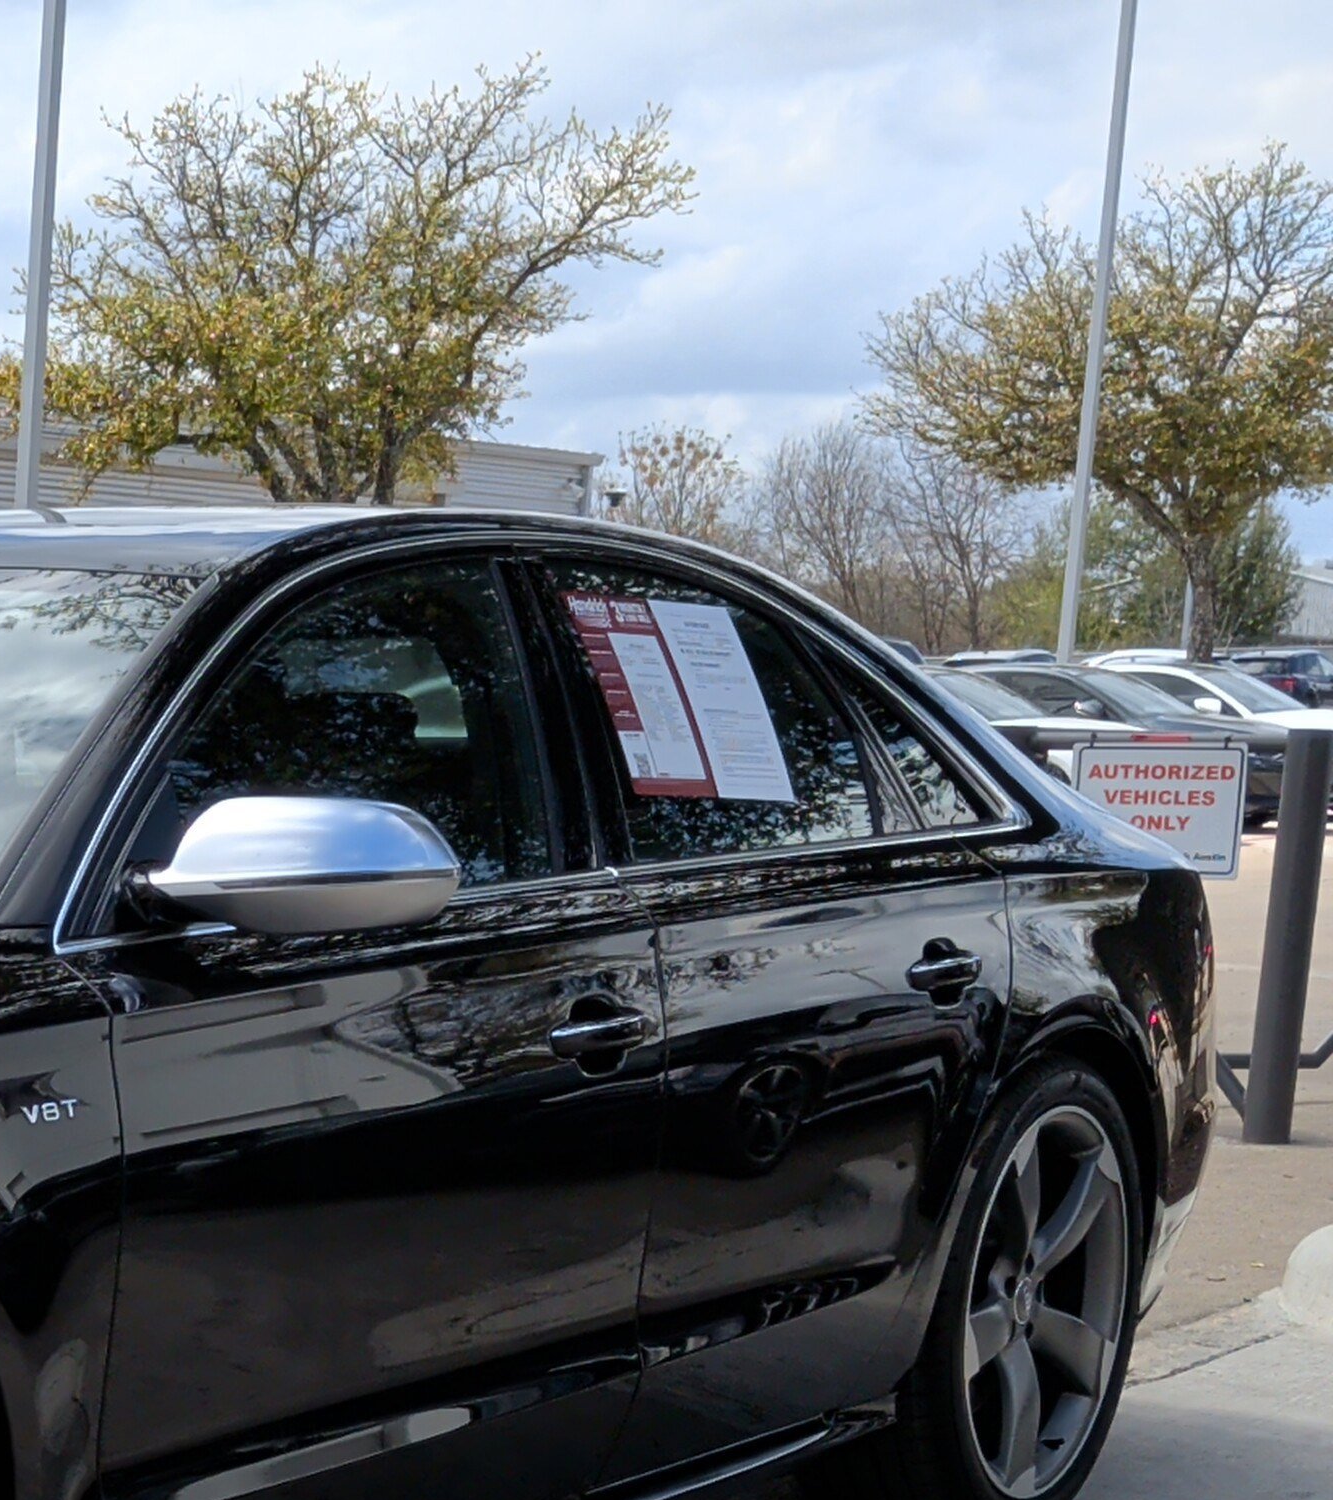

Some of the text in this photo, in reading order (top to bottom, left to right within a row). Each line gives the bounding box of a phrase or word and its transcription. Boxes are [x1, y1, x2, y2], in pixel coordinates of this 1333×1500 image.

[1088, 764, 1236, 781] AUTHORIZED
[1103, 789, 1216, 806] VEHICLES
[1129, 814, 1191, 831] ONLY
[19, 1098, 78, 1124] V8T
